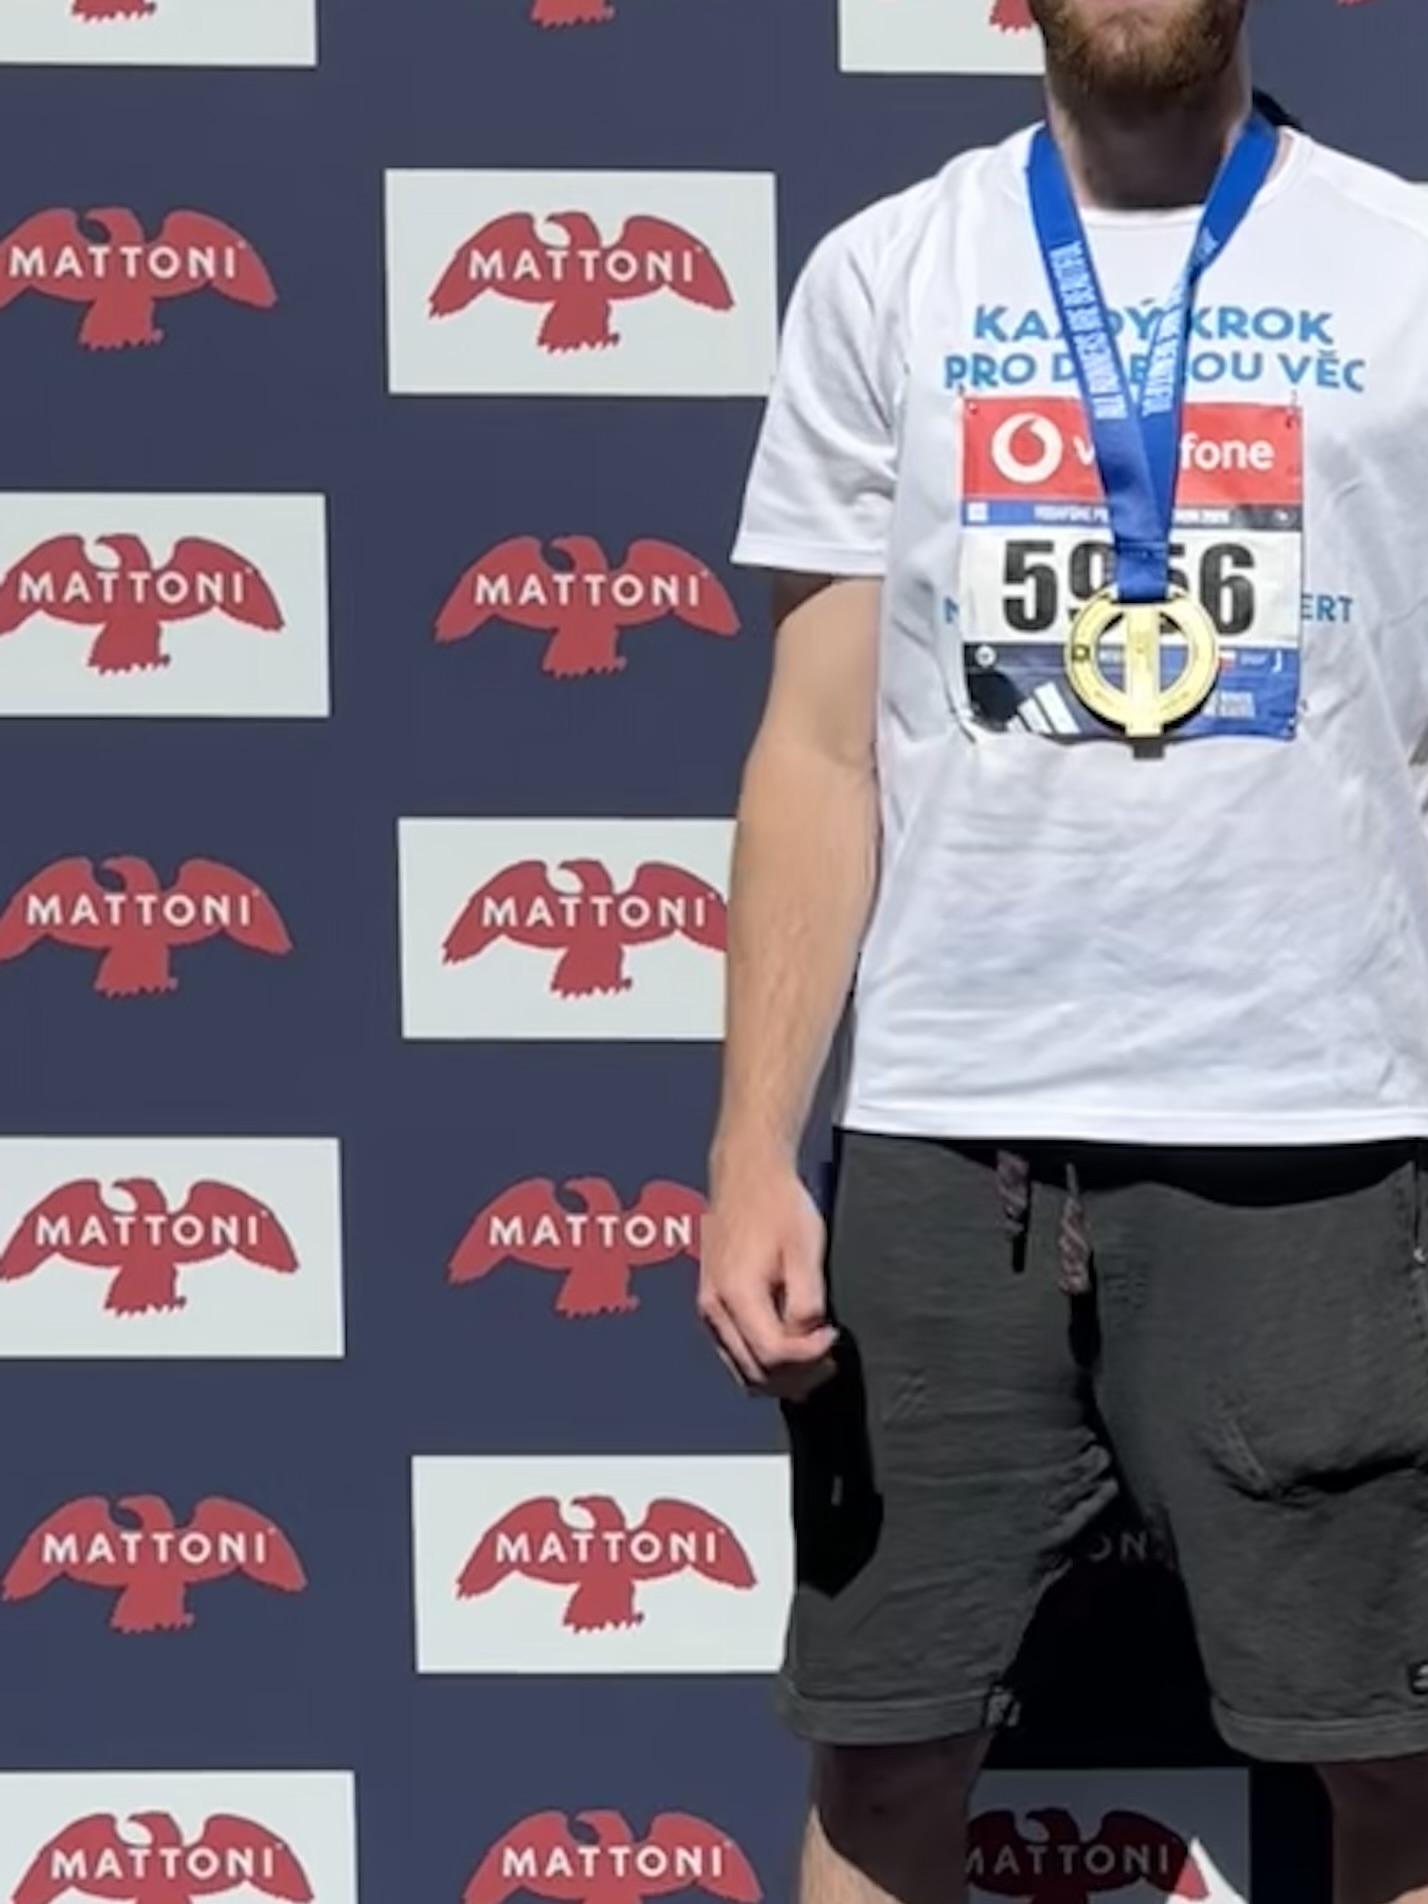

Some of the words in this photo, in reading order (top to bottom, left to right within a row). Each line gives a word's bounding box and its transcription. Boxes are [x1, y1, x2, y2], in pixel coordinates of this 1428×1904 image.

[10, 246, 234, 278] MATTONI
[469, 249, 692, 282] MATTONI
[973, 298, 1164, 342] KADÝ
[944, 352, 1037, 390] PRO
[1051, 352, 1264, 386] DBOU
[1278, 349, 1366, 393] VĚC
[1073, 433, 1276, 470] vfone
[19, 571, 242, 603] MATTONI
[476, 574, 698, 606] MATTONI
[1300, 594, 1353, 623] ERT
[27, 894, 249, 926] MATTONI
[483, 896, 704, 927] MATTONI
[36, 1215, 257, 1245] MATTONI
[489, 1214, 693, 1246] MATTON
[43, 1532, 264, 1563] MATTONI
[496, 1531, 715, 1563] MATTONI
[51, 1847, 273, 1879] MATTONI
[503, 1845, 721, 1877] MATTONI
